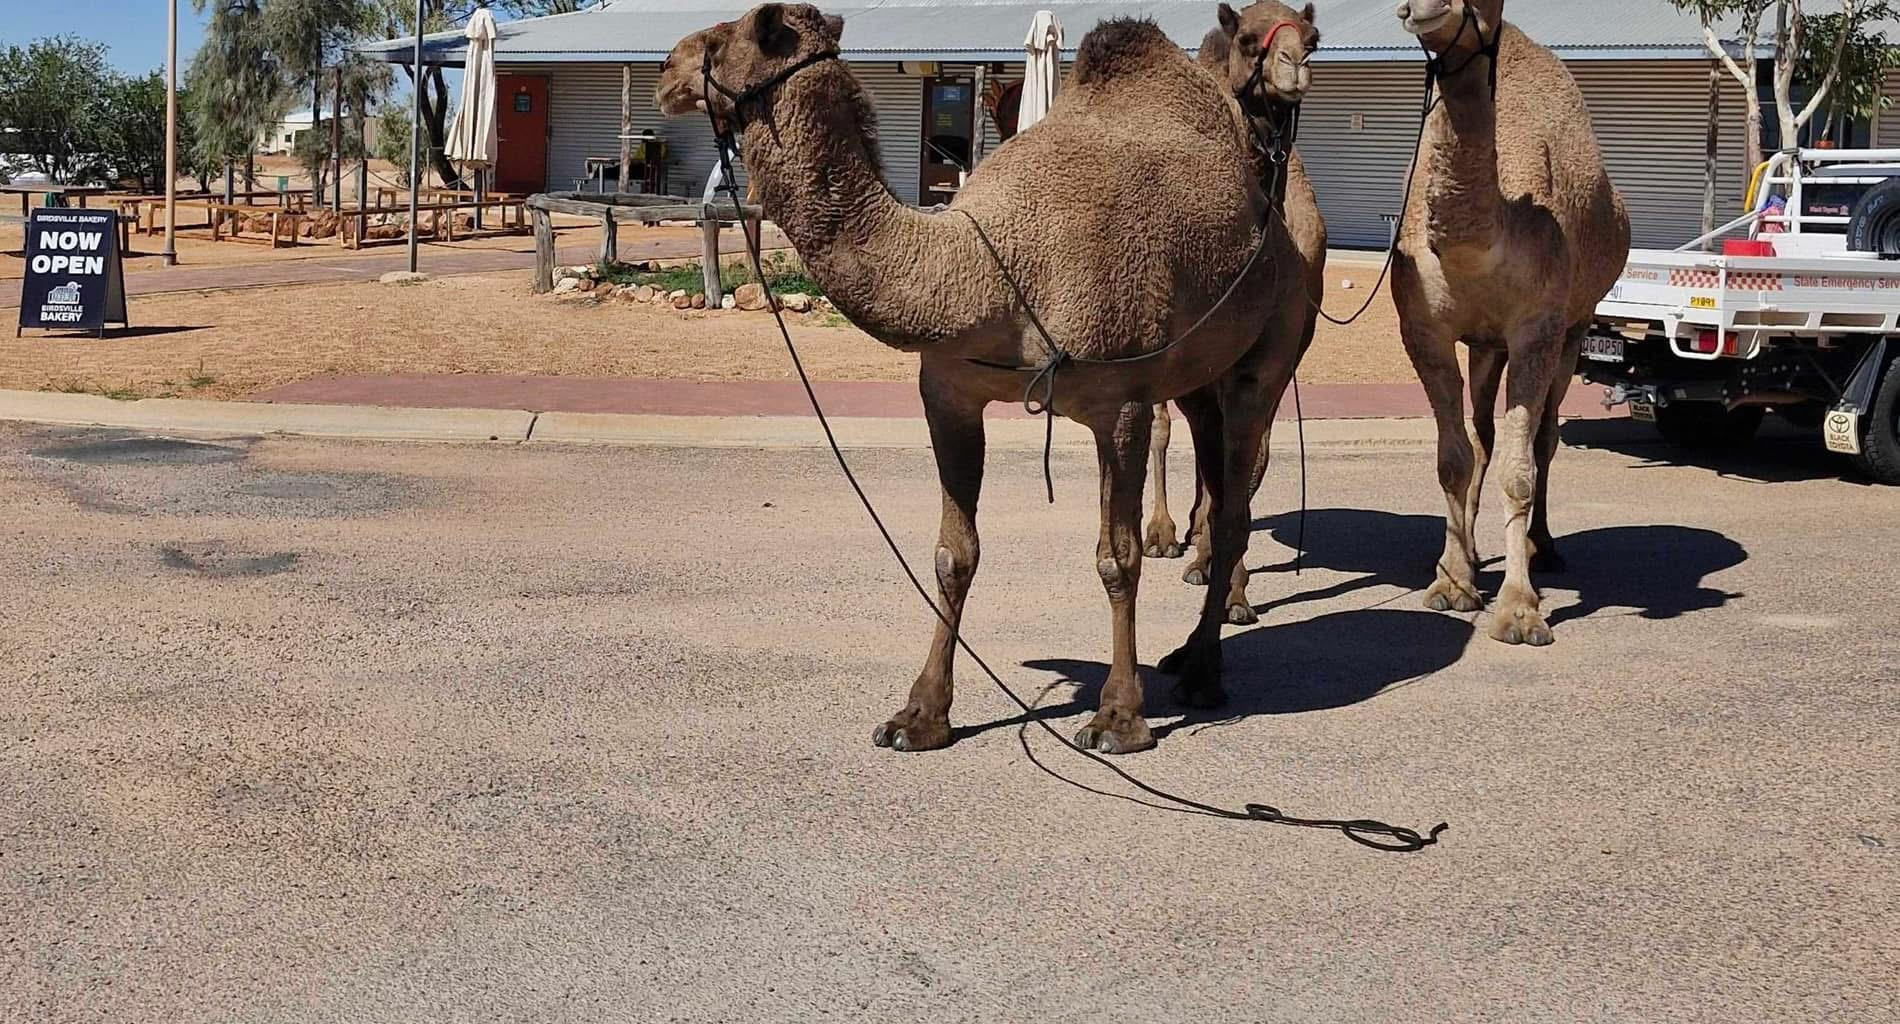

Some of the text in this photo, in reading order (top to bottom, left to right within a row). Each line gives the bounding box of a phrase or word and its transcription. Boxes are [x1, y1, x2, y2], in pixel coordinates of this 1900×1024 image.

[36, 215, 108, 224] BIRDSVILLE BAKERY
[40, 231, 102, 250] NOW
[31, 255, 104, 275] OPEN
[1626, 267, 1659, 280] Service
[1793, 275, 1818, 287] State
[1821, 276, 1876, 292] Emergency
[40, 312, 82, 322] BAKERY
